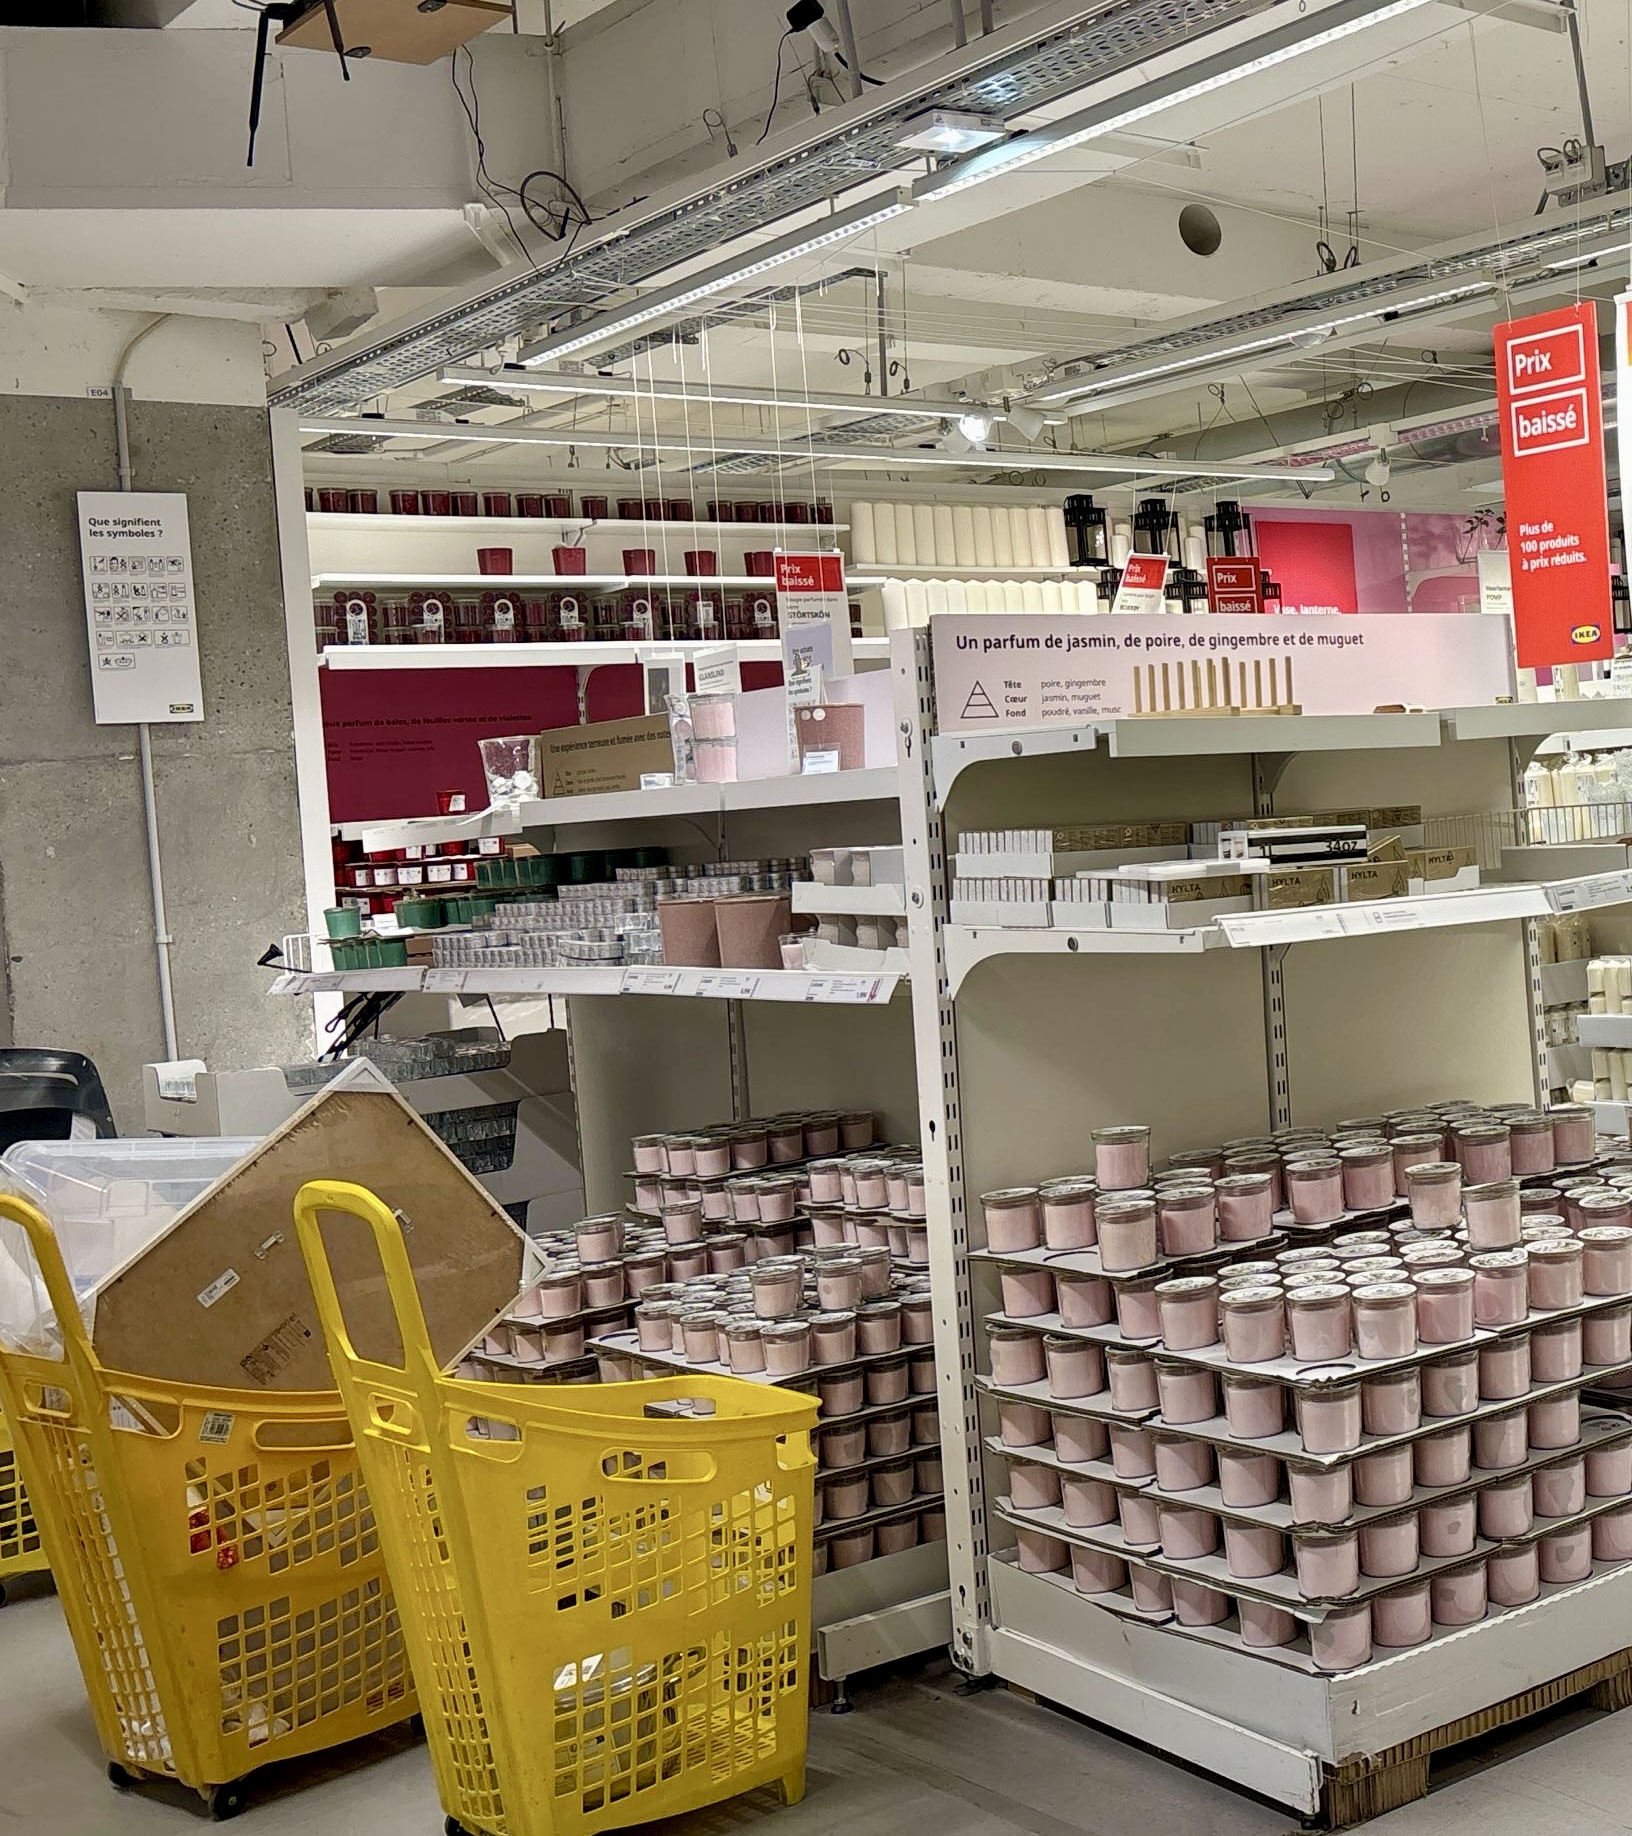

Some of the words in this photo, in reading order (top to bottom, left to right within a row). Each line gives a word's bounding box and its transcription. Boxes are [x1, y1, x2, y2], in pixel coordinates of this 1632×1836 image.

[1515, 349, 1552, 377] Prix
[1519, 404, 1577, 438] baissé
[88, 518, 110, 528] Que
[112, 517, 162, 528] signifient
[1519, 523, 1540, 537] Plus
[1541, 520, 1554, 532] de
[89, 529, 104, 537] les
[106, 529, 155, 539] symboles
[1520, 540, 1538, 554] 100
[1539, 534, 1580, 554] produits
[1522, 557, 1529, 571] à
[1530, 555, 1550, 572] prix
[1551, 551, 1587, 567] réduits.
[780, 564, 801, 574] Prix
[781, 575, 815, 586] baissé
[1217, 572, 1237, 583] Prix
[1219, 601, 1252, 613] baissé
[1574, 630, 1597, 639] IKEA
[956, 635, 978, 649] Un
[983, 634, 1040, 653] parfum
[1044, 634, 1063, 649] de
[1066, 633, 1121, 652] jasmin,
[1124, 633, 1141, 648] de
[1145, 632, 1185, 651] poire,
[1188, 633, 1205, 647] de
[1209, 632, 1280, 650] gingembre
[1283, 634, 1296, 646] et
[1299, 632, 1314, 646] de
[1317, 633, 1364, 649] muguet
[1003, 680, 1022, 690] Tête
[1040, 679, 1064, 691] poire,
[1064, 679, 1106, 692] gingembre
[1004, 695, 1028, 703] Cœur
[1041, 692, 1069, 704] jasmin,
[1071, 692, 1101, 704] muguet
[1005, 708, 1026, 718] Fond
[1041, 706, 1072, 719] poudré,
[1073, 705, 1100, 716] vanille,
[1101, 706, 1122, 714] musc
[1324, 840, 1358, 854] 34oz
[1351, 870, 1378, 880] HYLTA
[1271, 877, 1301, 887] HYLTA
[1172, 884, 1201, 893] HYLTA
